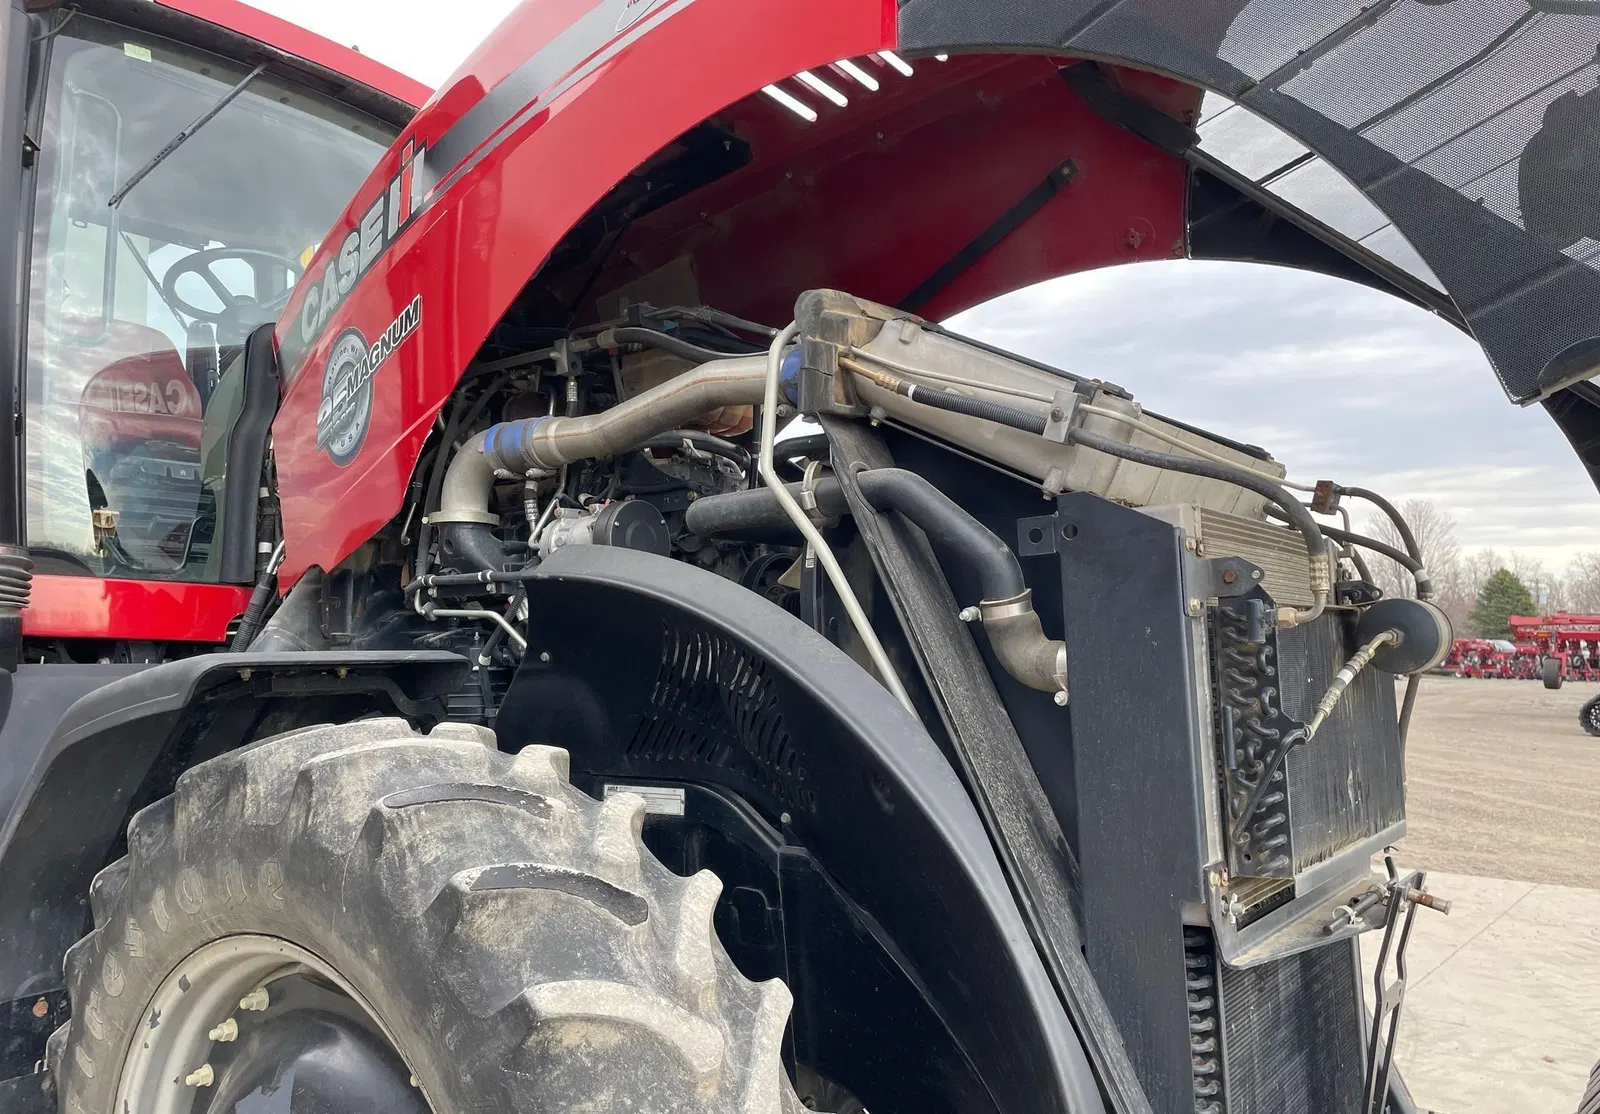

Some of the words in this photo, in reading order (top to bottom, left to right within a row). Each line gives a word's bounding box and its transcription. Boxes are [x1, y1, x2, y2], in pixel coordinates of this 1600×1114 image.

[301, 194, 385, 344] CASE
[346, 294, 420, 401] MAGNUM
[316, 372, 350, 450] 25
[340, 422, 361, 447] USA
